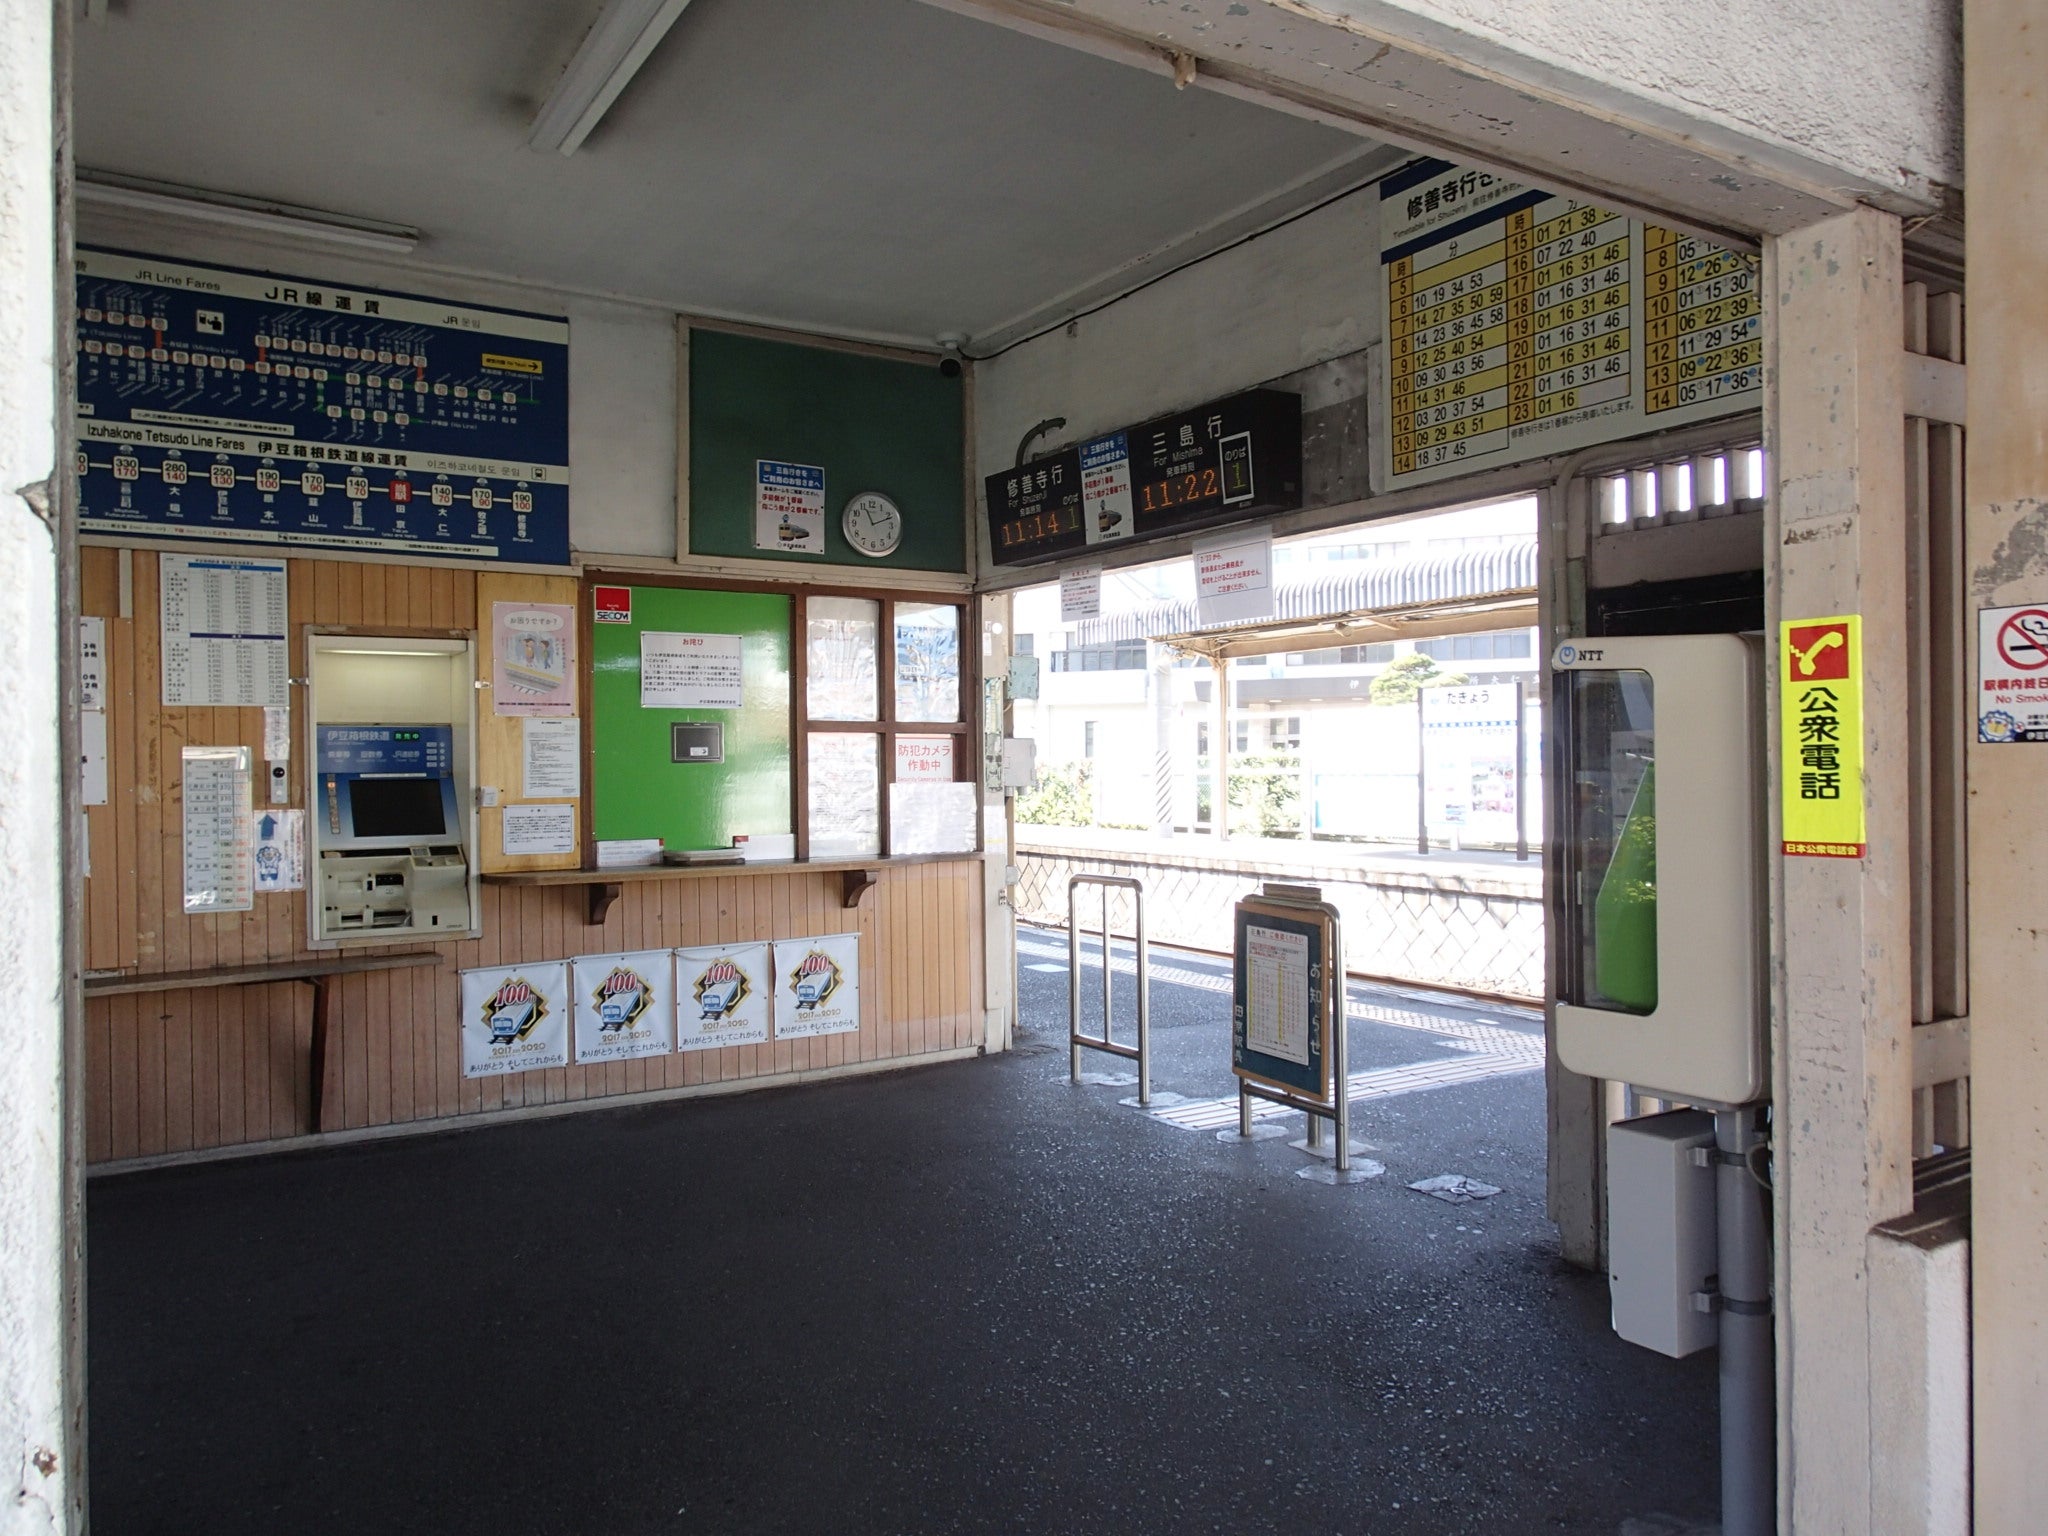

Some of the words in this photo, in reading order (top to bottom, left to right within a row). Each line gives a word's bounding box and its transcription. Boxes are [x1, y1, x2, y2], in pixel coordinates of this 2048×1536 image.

[1513, 234, 1527, 251] 15
[1537, 226, 1550, 243] 01
[1558, 217, 1572, 235] 21
[1581, 208, 1596, 226] 38
[1513, 256, 1527, 274] 16
[1537, 247, 1551, 264] 07
[1559, 239, 1573, 256] 22
[1581, 230, 1596, 247] 40
[1513, 276, 1527, 294] 17
[1537, 269, 1550, 286] 01
[1560, 261, 1573, 278] 16
[1581, 253, 1595, 270] 31
[1604, 244, 1620, 261] 46
[1658, 274, 1668, 291] 9
[1680, 266, 1695, 284] 12
[1705, 258, 1721, 276] 26
[135, 270, 153, 281] JR
[156, 273, 181, 285] Line
[187, 277, 220, 291] Fares
[1400, 300, 1407, 314] 6
[1415, 294, 1426, 309] 10
[1433, 287, 1444, 302] 19
[1451, 280, 1464, 296] 34
[1470, 273, 1482, 289] 53
[1652, 297, 1668, 316] 10
[1679, 290, 1694, 308] 01
[1705, 282, 1721, 300] 15
[1730, 273, 1747, 292] 30
[1400, 320, 1406, 334] 7
[1416, 313, 1426, 328] 14
[1433, 307, 1445, 323] 27
[1451, 300, 1464, 316] 35
[1471, 294, 1483, 310] 50
[1490, 287, 1502, 303] 59
[442, 316, 458, 326] JR
[1401, 339, 1407, 353] 8
[1416, 333, 1426, 348] 14
[1434, 327, 1445, 343] 23
[1452, 321, 1464, 336] 36
[1471, 314, 1483, 329] 45
[1490, 308, 1503, 323] 58
[1652, 343, 1669, 362] 12
[1680, 337, 1694, 354] 11
[1705, 330, 1721, 348] 29
[1731, 322, 1748, 341] 54
[1514, 404, 1528, 421] 23
[1538, 398, 1551, 414] 01
[1561, 392, 1574, 408] 16
[87, 424, 142, 441] Izuhakone
[145, 430, 189, 445] Tetsudo
[192, 435, 213, 448] Line
[216, 438, 245, 450] Fares
[1152, 415, 1222, 455] 三島行
[258, 441, 408, 466] 伊豆箱根鉄道線運賃
[1154, 456, 1167, 467] For
[1172, 447, 1204, 462] Mishima
[1224, 446, 1246, 461] のりば
[116, 458, 137, 468] 330
[164, 463, 185, 472] 280
[213, 467, 233, 476] 250
[259, 471, 277, 480] 190
[1232, 462, 1246, 489] 1
[305, 475, 322, 484] 170
[349, 479, 366, 488] 140
[1007, 464, 1063, 498] 修善寺行
[434, 487, 450, 495] 140
[474, 491, 490, 499] 170
[1143, 468, 1218, 512] 11:22
[514, 494, 530, 502] 190
[1008, 500, 1018, 508] For
[1068, 505, 1079, 529] 1
[1003, 512, 1059, 546] 11:14
[597, 611, 628, 620] SECOM
[1579, 651, 1603, 661] NTT
[1448, 690, 1489, 704] たきょう
[1995, 695, 2011, 704] No
[327, 731, 389, 741] 伊豆箱根鉄道
[1799, 686, 1840, 799] 公衆電話
[898, 745, 950, 756] 防犯カメラ
[908, 759, 940, 771] 作動中
[1786, 844, 1858, 856] 日本公衆電話会
[821, 1009, 841, 1017] 2020
[702, 1022, 718, 1030] 2017
[727, 1019, 749, 1027] 2020
[780, 1026, 807, 1035] ありがとう
[810, 1020, 855, 1031] そしてこれからも
[602, 1033, 620, 1042] 2017
[629, 1030, 651, 1040] 2020
[682, 1036, 712, 1045] ありがとう
[714, 1031, 764, 1042] そしてこれからも
[492, 1047, 512, 1056] 2017
[521, 1042, 545, 1051] 2020
[581, 1049, 613, 1059] ありがとう
[616, 1042, 668, 1054] そしてこれからも
[470, 1062, 504, 1072] ありがとう
[507, 1054, 564, 1068] そしてこれからも
